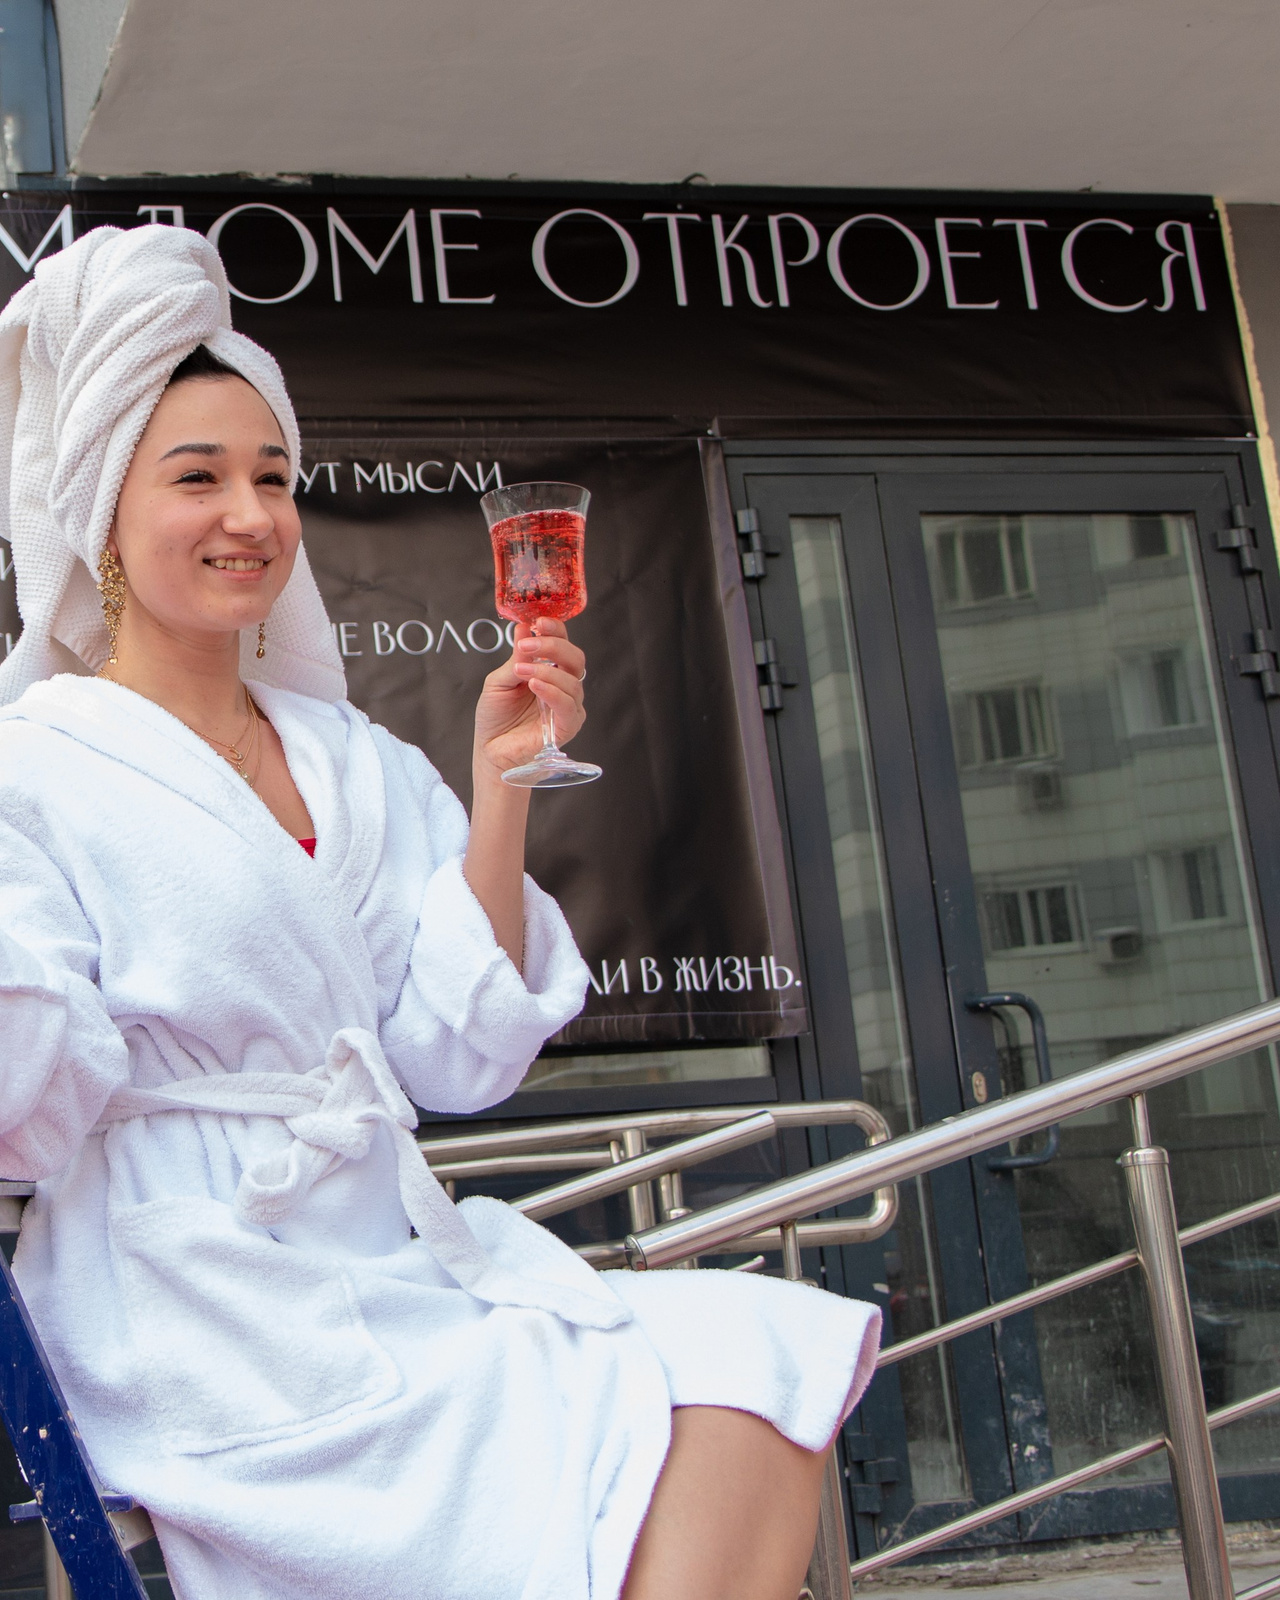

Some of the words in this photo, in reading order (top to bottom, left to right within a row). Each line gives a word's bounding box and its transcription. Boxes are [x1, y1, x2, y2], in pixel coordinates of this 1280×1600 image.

[531, 208, 1208, 313] ОТКРОЕТСЯ
[353, 460, 505, 495] МЫСЛИ
[331, 621, 363, 657] Е
[639, 956, 663, 994] В
[673, 954, 803, 994] ЖИЗНЬ.
